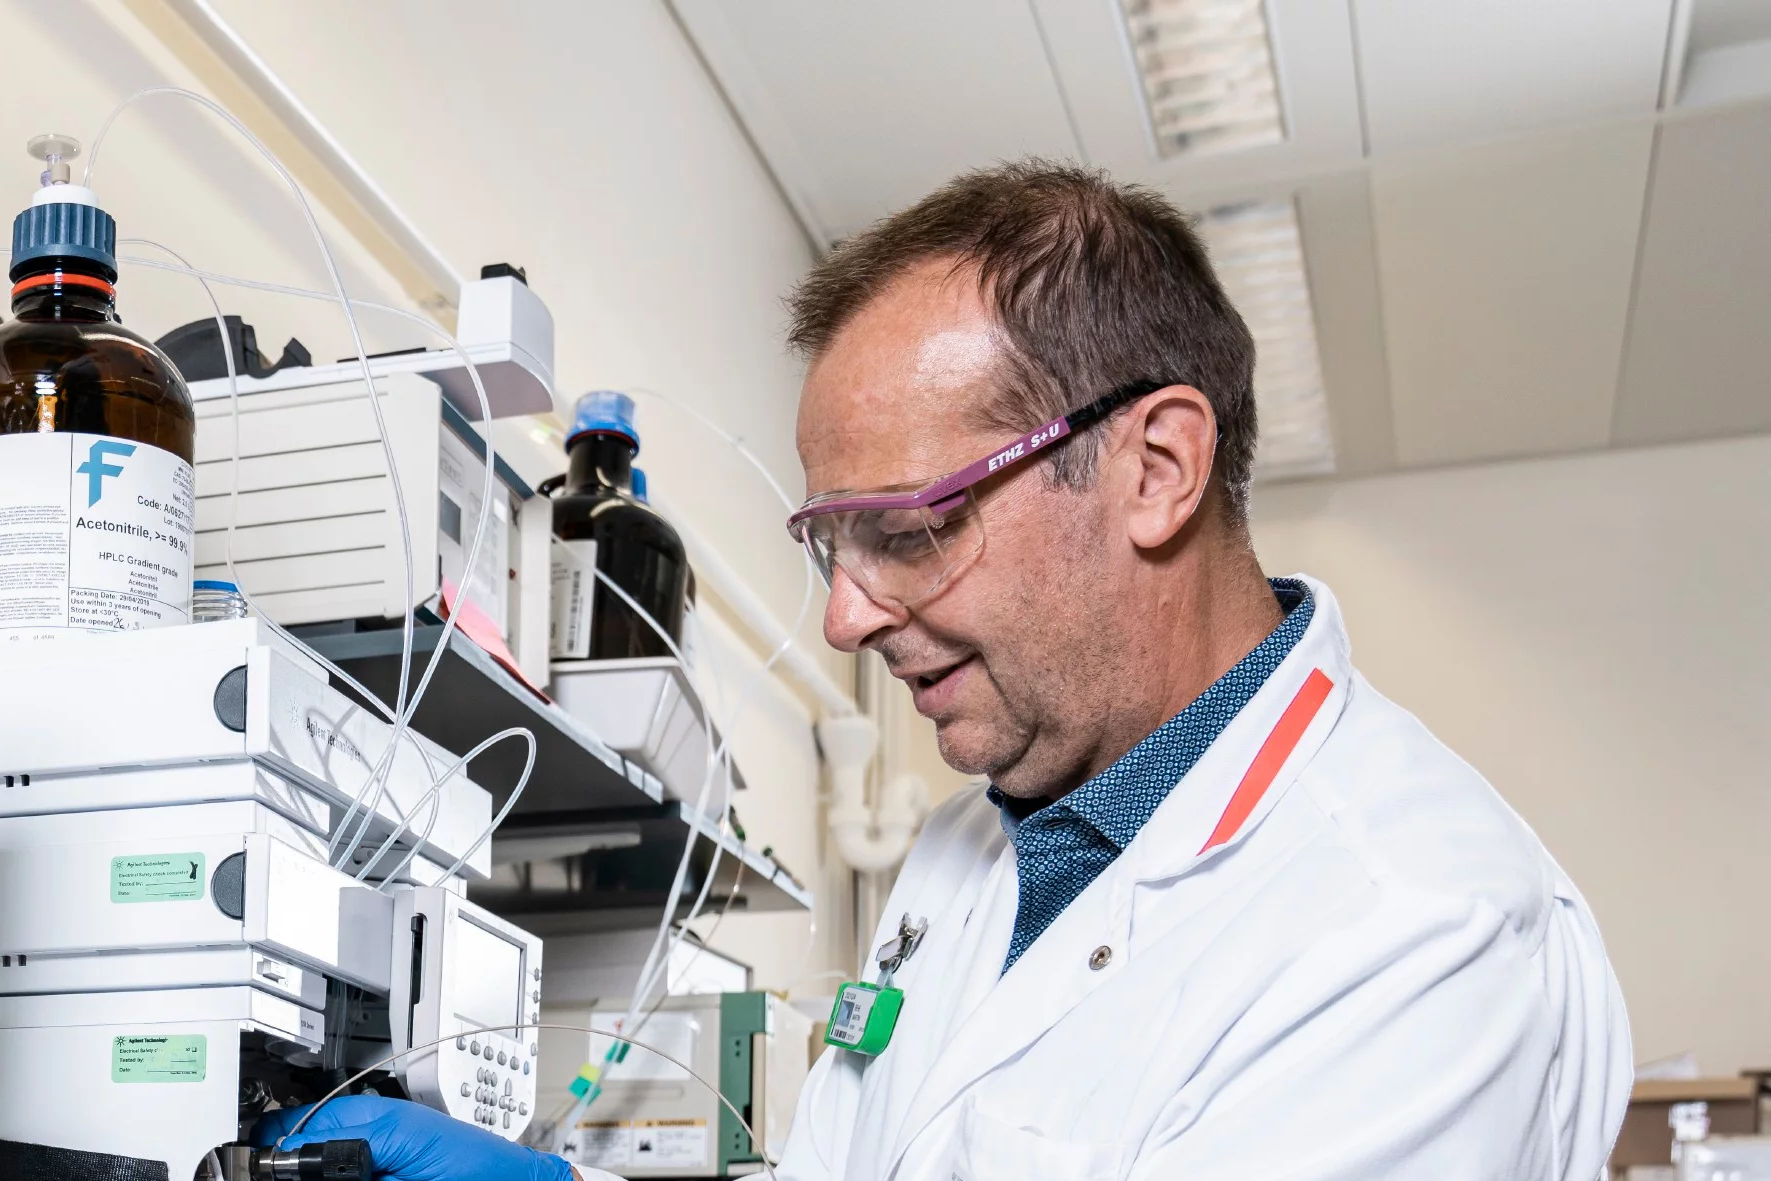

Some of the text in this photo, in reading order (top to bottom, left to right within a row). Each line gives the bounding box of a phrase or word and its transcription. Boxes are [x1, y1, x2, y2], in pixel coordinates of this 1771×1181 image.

[988, 423, 1060, 472] ETHZ S+U
[137, 495, 162, 511] Code:
[76, 517, 153, 541] Acetonitrile,
[169, 535, 189, 556] 99.9%
[99, 551, 178, 578] HPLC Gradient grade
[70, 590, 99, 599] Packing
[101, 592, 118, 600] Date:
[87, 599, 107, 607] within
[140, 607, 162, 619] opening
[88, 619, 113, 627] opened
